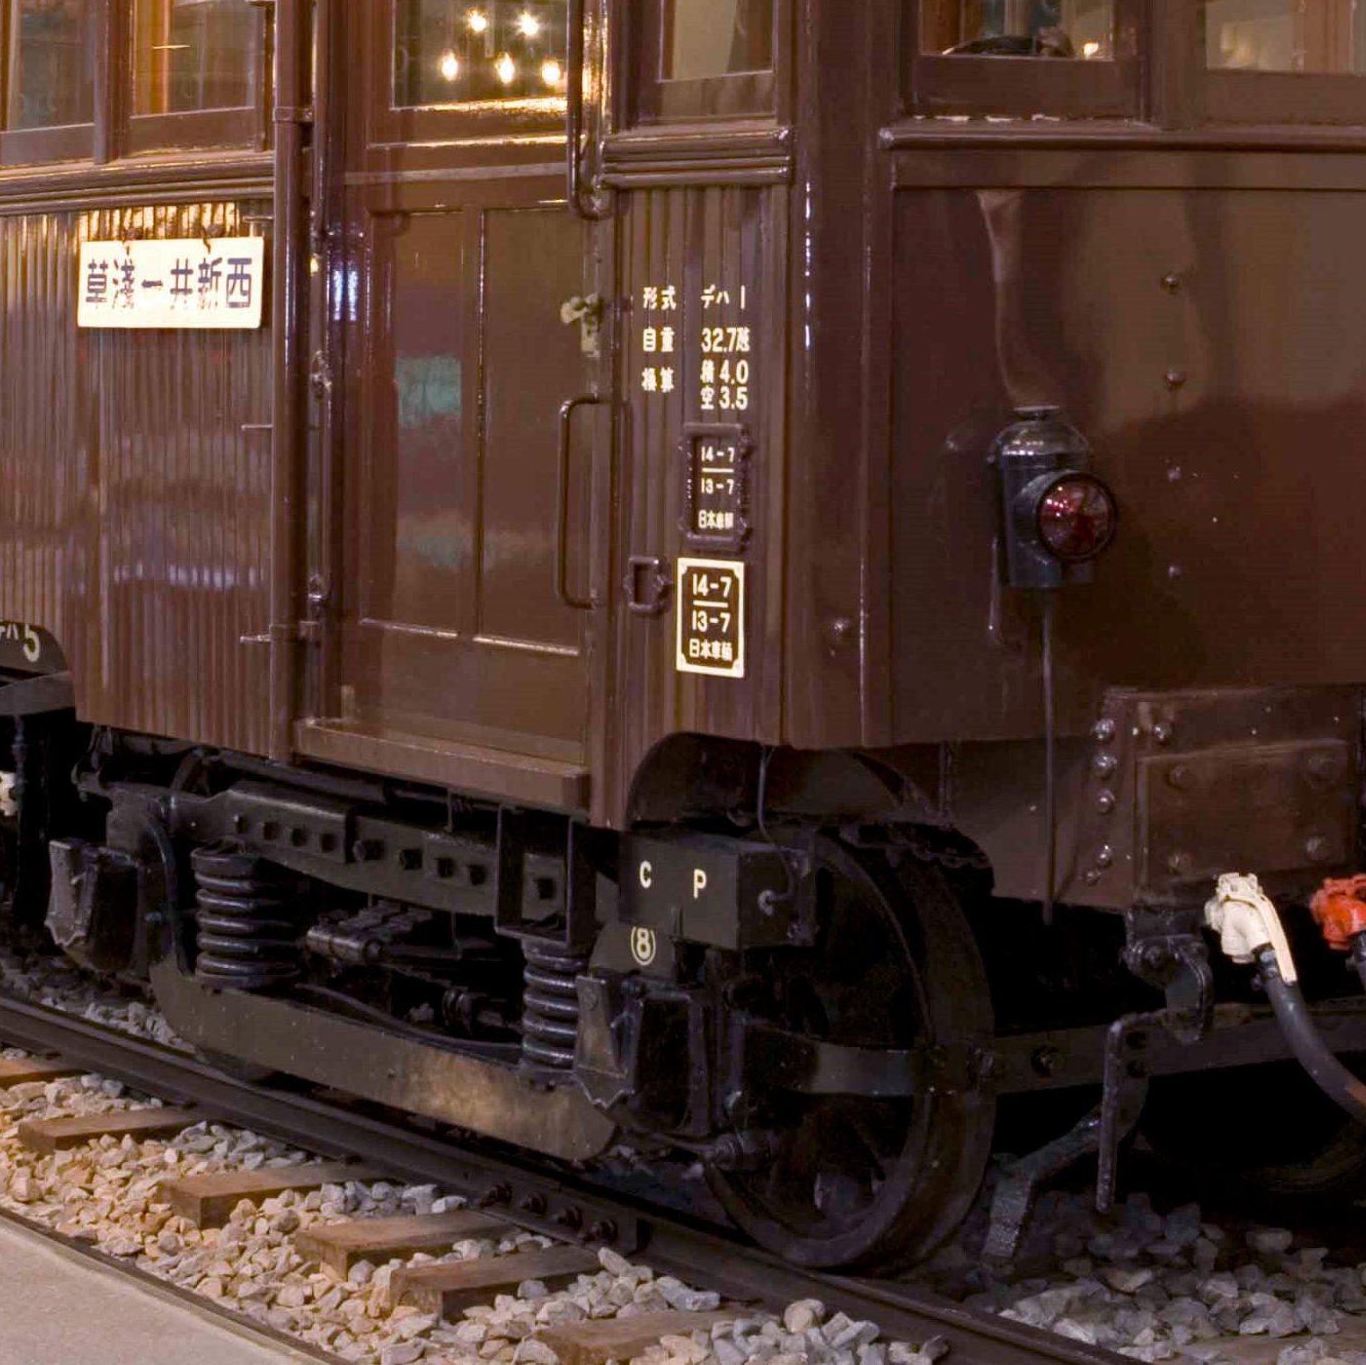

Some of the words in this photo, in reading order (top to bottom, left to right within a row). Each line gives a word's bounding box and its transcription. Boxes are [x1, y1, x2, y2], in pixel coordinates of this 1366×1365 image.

[642, 327, 675, 352] 自重
[639, 860, 652, 889] C
[693, 868, 707, 899] P
